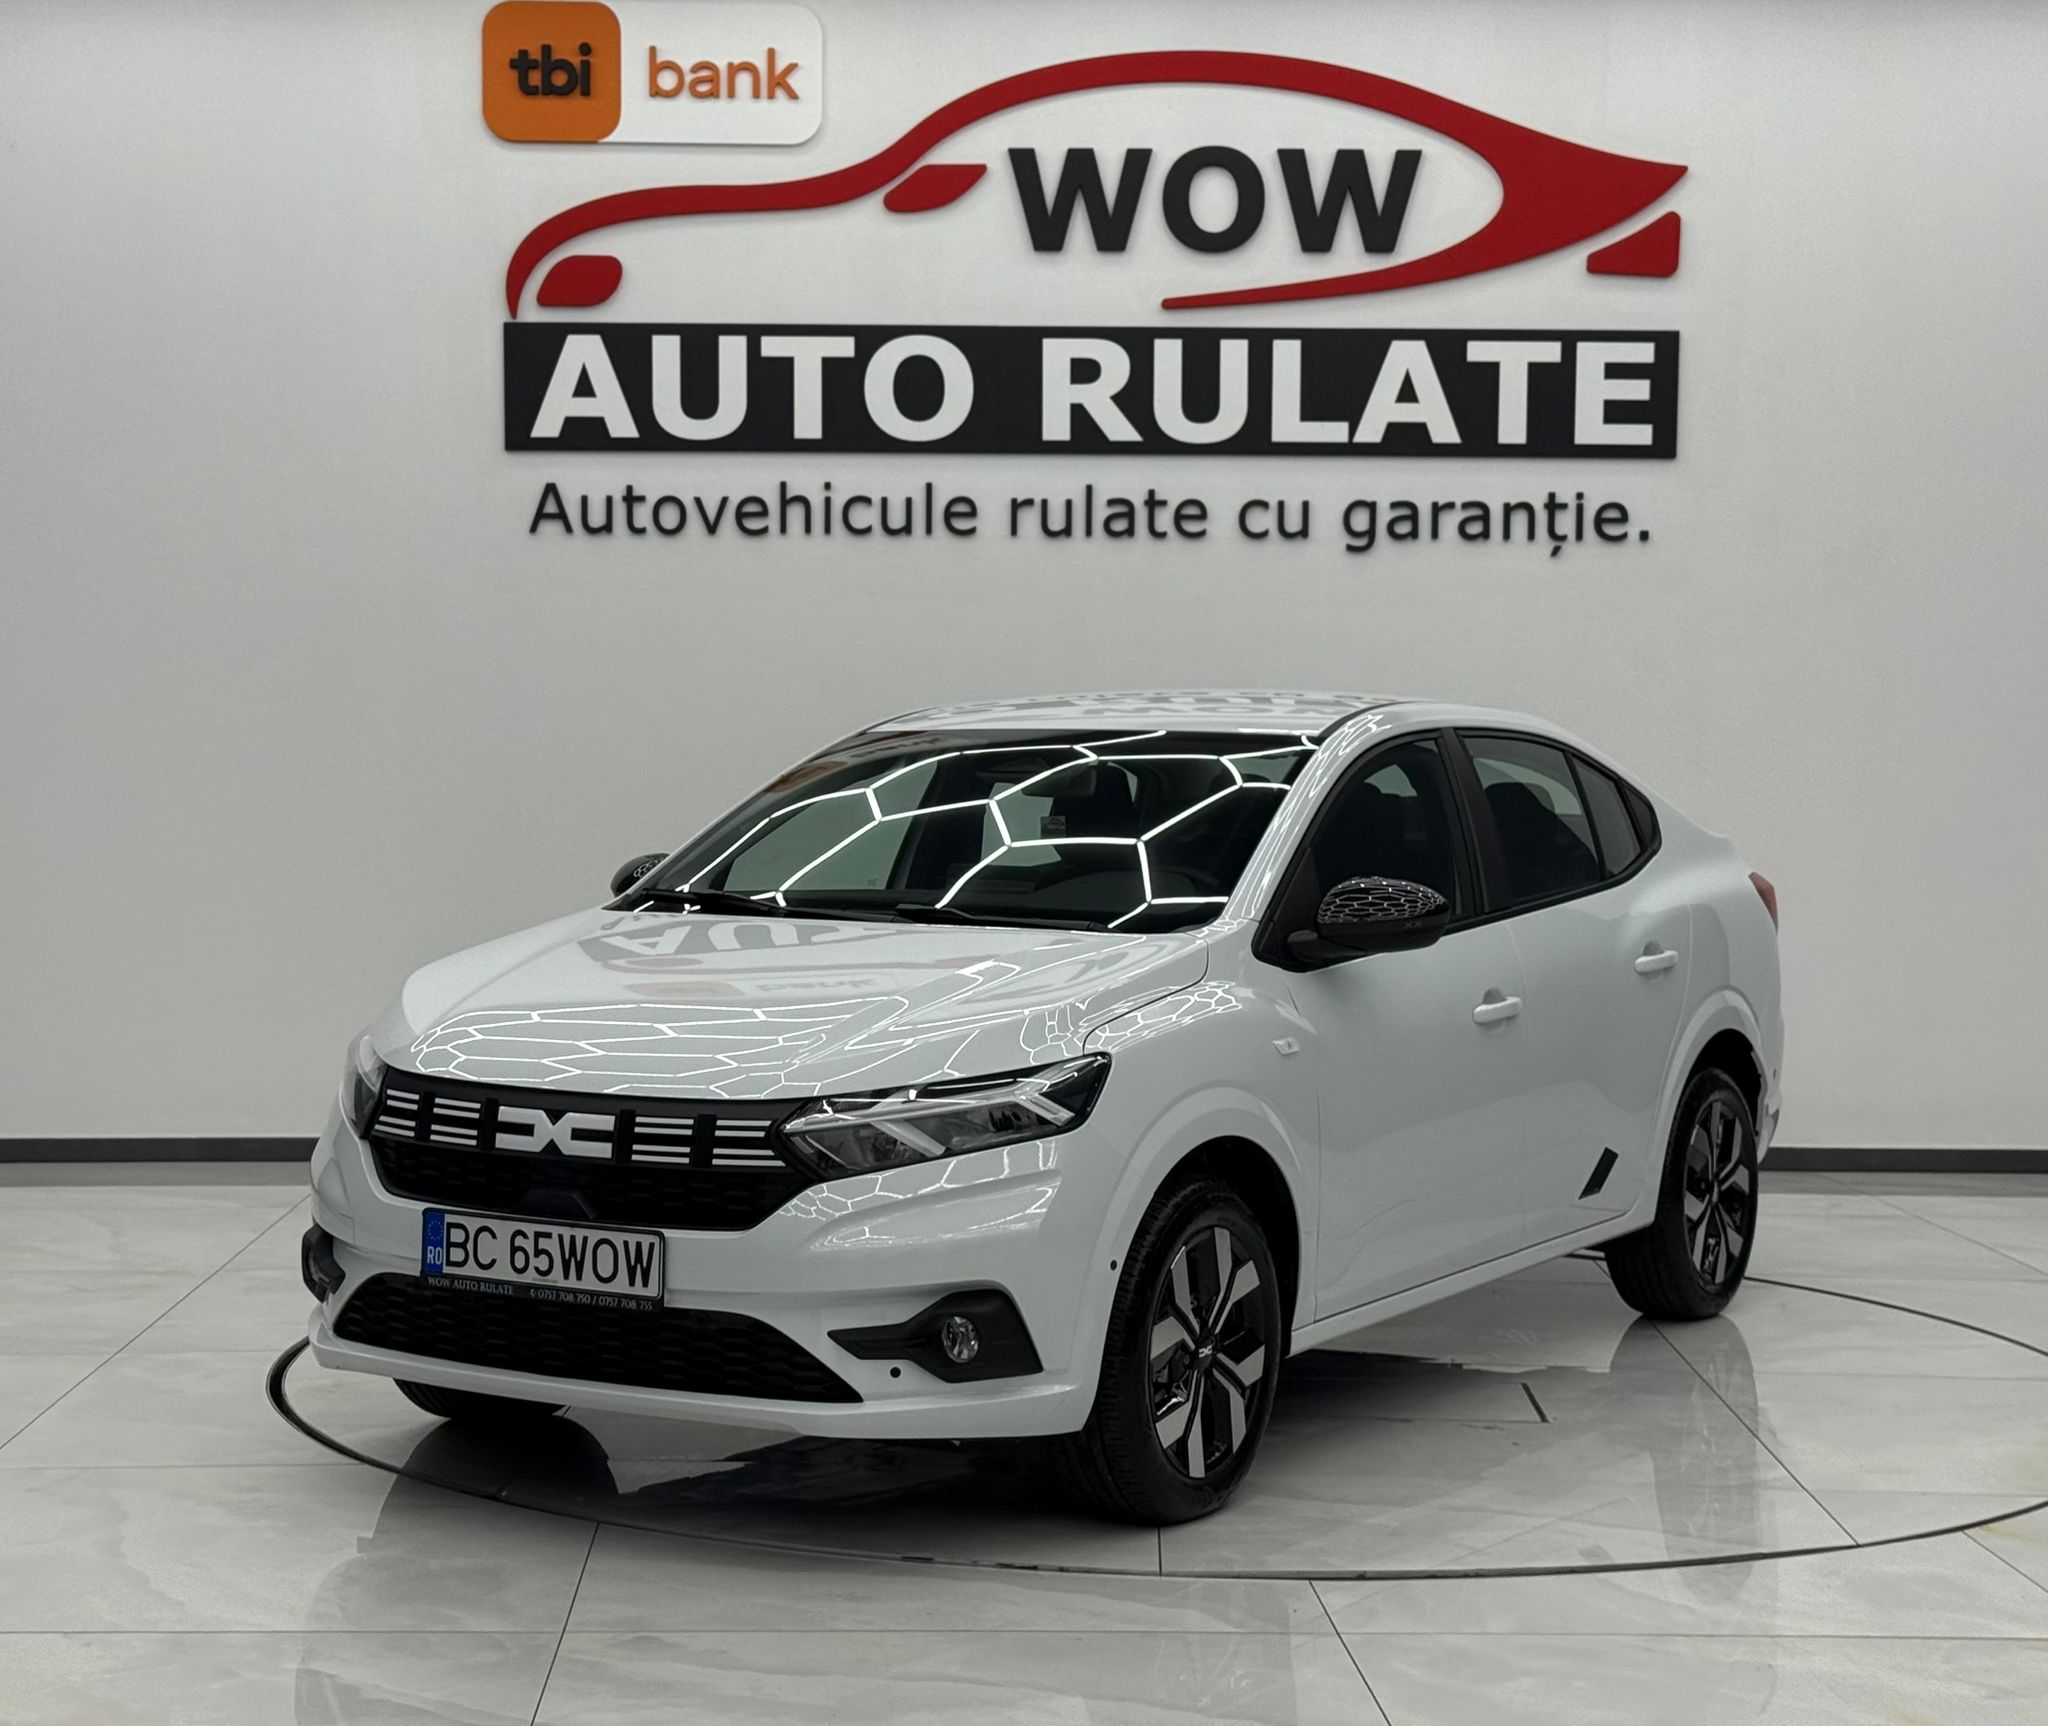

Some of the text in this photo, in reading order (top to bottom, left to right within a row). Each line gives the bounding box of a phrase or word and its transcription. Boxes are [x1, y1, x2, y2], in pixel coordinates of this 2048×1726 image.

[509, 42, 799, 99] tbi bank
[1007, 145, 1423, 254] WOW
[530, 334, 1656, 446] AUTO RULATE
[528, 481, 1650, 557] Autovehicule rulate cu garanție.
[427, 1246, 443, 1265] RO
[428, 1276, 451, 1287] WOW
[452, 1279, 479, 1291] AUTO
[480, 1283, 515, 1295] RULATE
[445, 1222, 656, 1289] BC 65WOW
